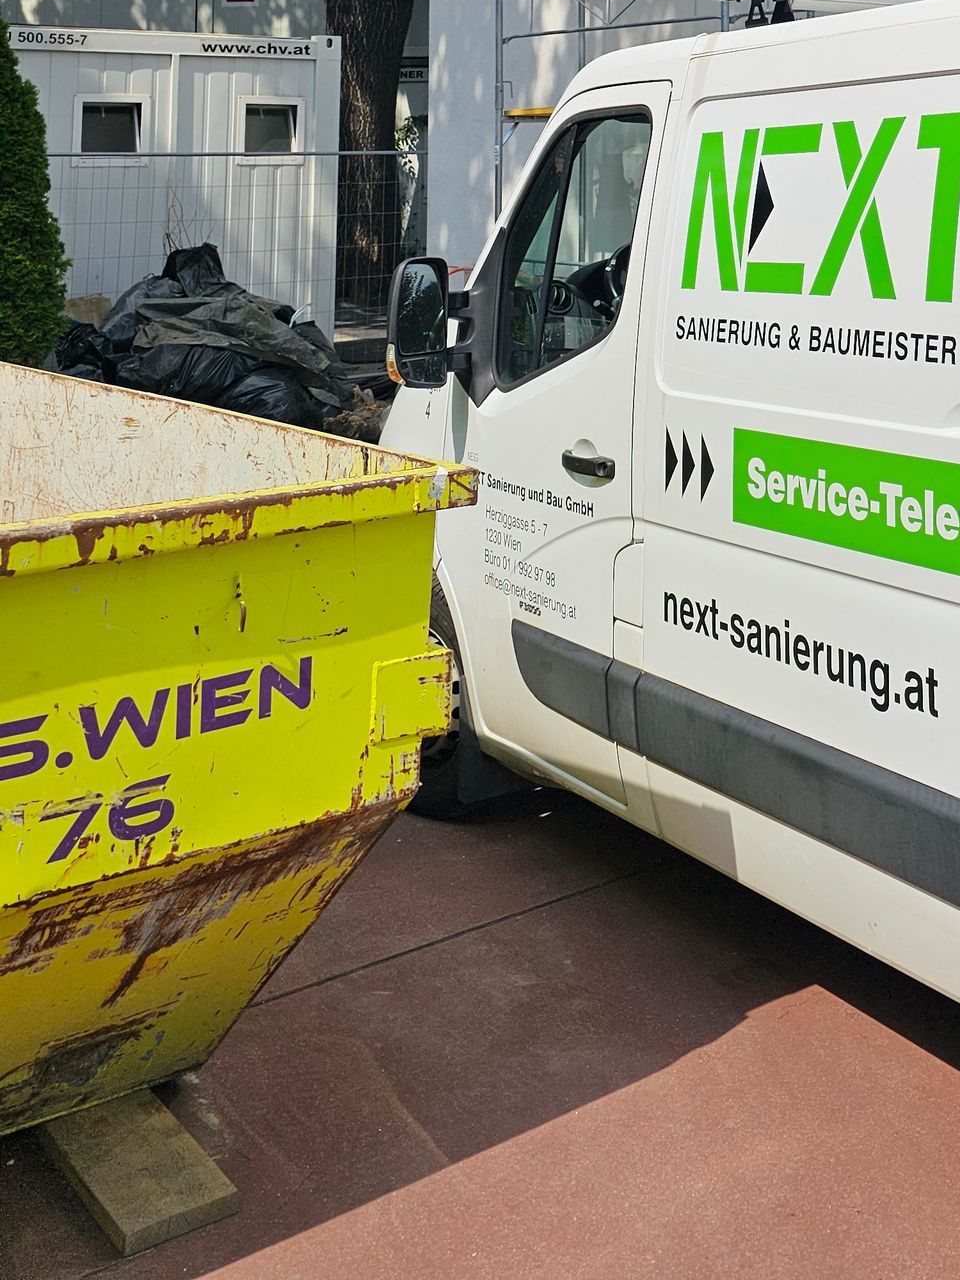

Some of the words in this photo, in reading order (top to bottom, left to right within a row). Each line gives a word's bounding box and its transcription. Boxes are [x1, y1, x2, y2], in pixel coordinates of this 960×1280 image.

[17, 31, 88, 46] 500.555-7
[202, 42, 311, 57] www.chv.at
[400, 70, 424, 79] NER
[675, 315, 781, 349] SANIERUNG
[788, 324, 801, 351] &
[808, 325, 957, 365] BAUMEISTER
[487, 473, 526, 502] Sanierung
[528, 487, 544, 503] und
[546, 490, 563, 509] Bau
[565, 495, 594, 518] GmbH
[485, 504, 529, 531] Herziggasse
[530, 519, 536, 534] 5
[542, 522, 548, 537] 7
[485, 527, 502, 545] 1230
[503, 532, 522, 553] Wien
[484, 548, 501, 568] Büro
[502, 555, 511, 571] 01
[518, 561, 533, 578] 992
[534, 566, 544, 582] 97
[545, 570, 556, 588] 98
[484, 571, 577, 620] office@next-sanierung.at
[662, 587, 940, 719] next-sanierung.at
[39, 773, 175, 865] 76
